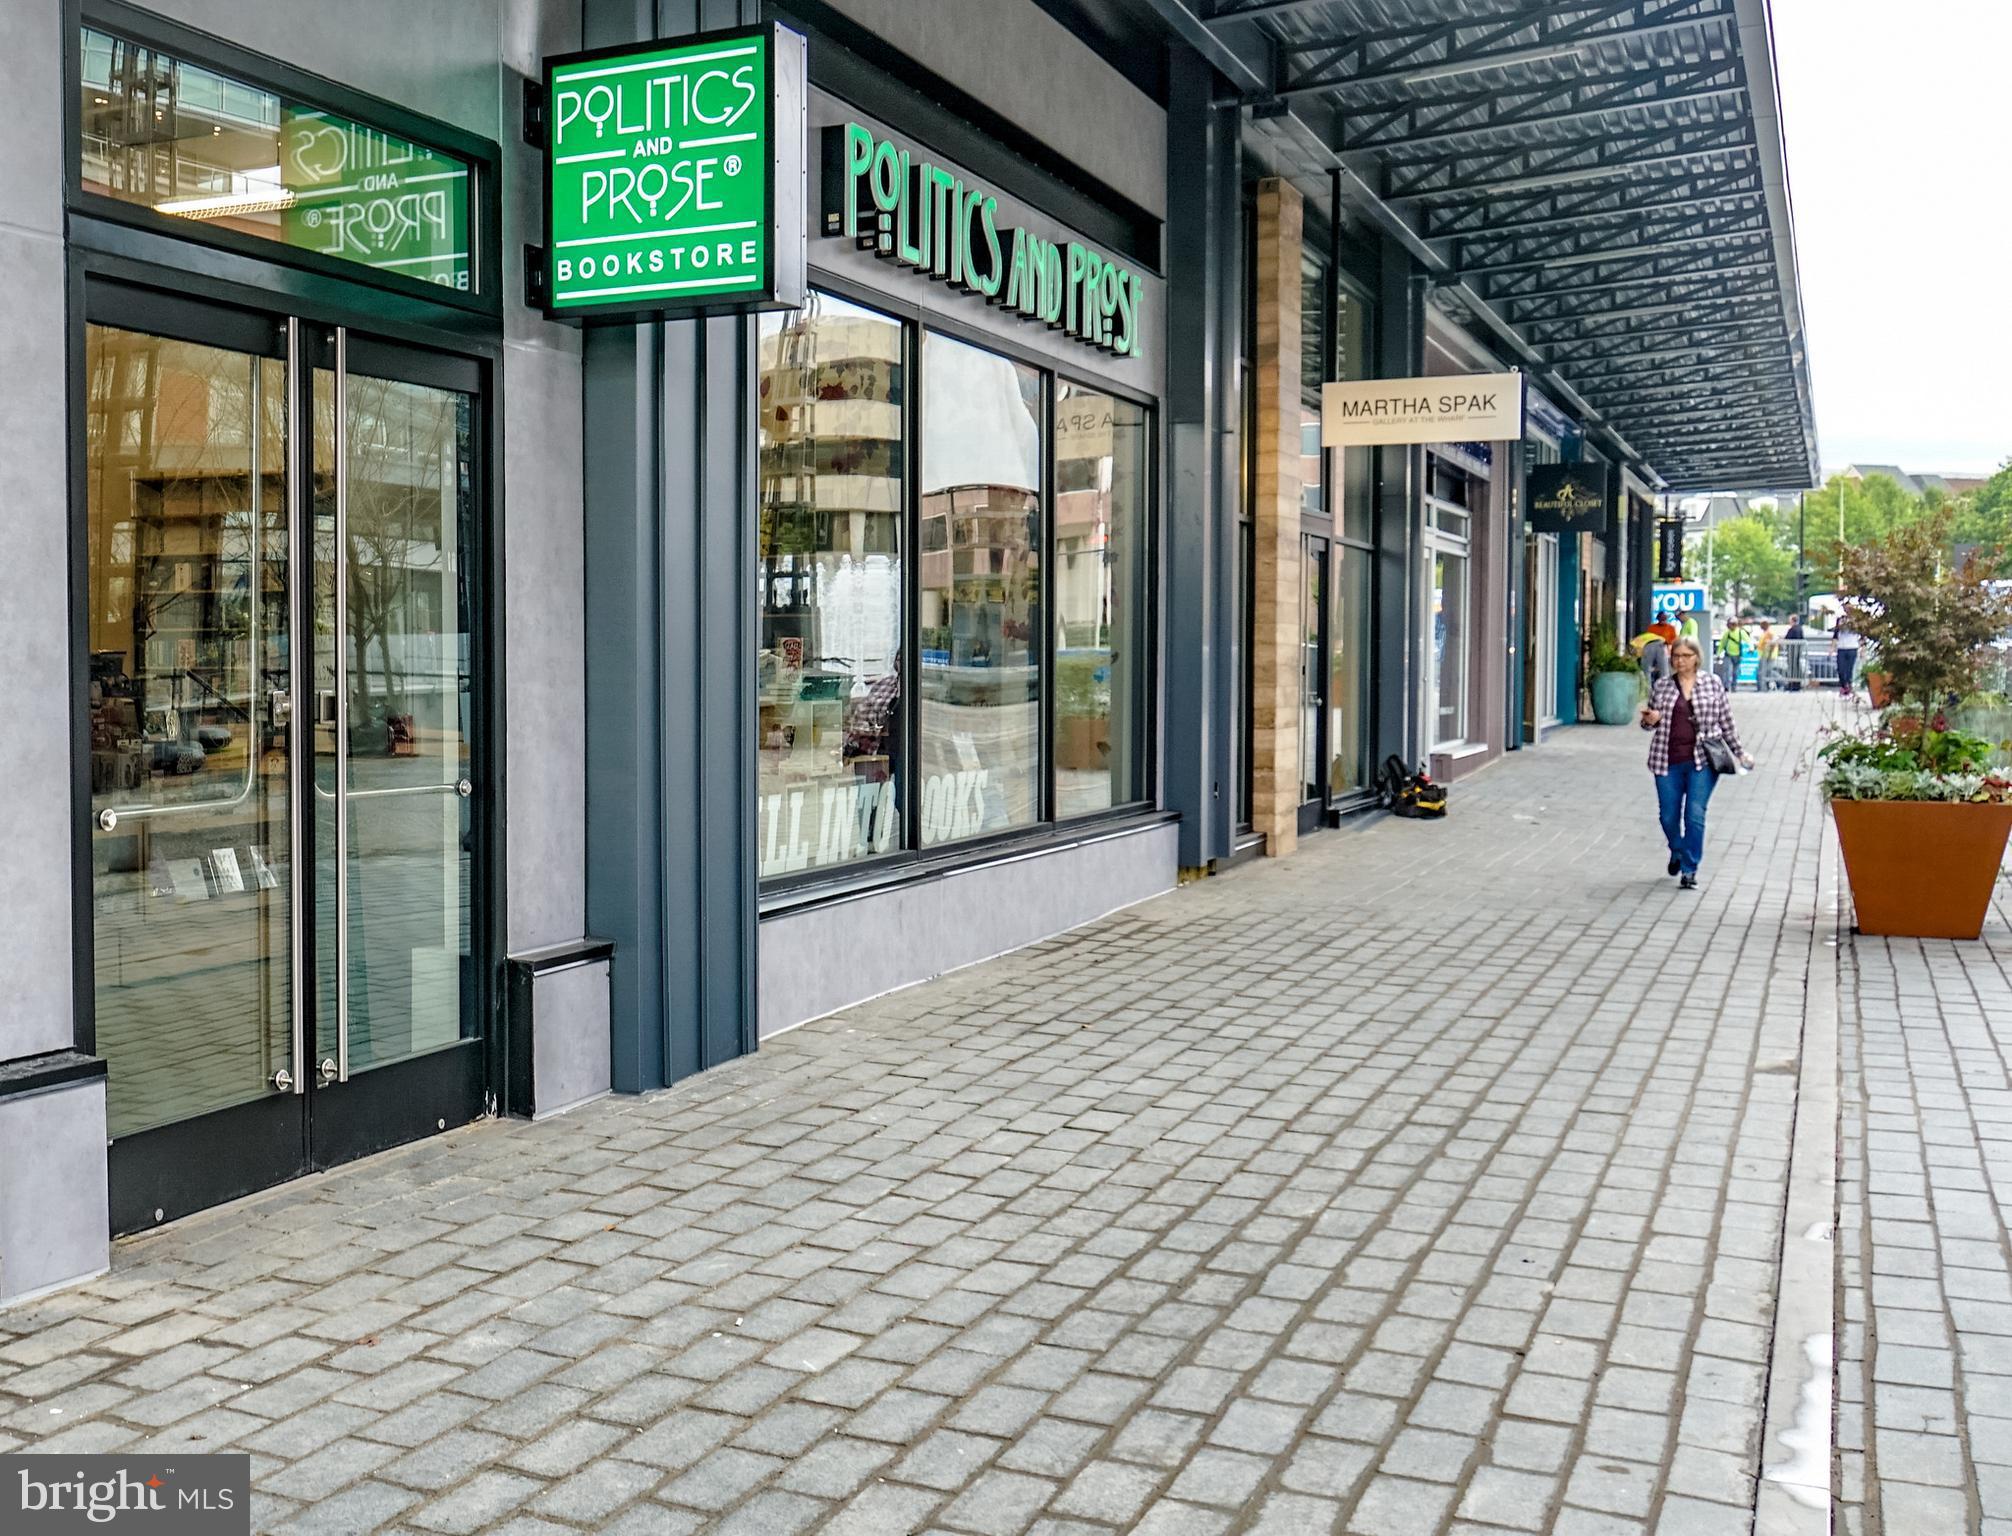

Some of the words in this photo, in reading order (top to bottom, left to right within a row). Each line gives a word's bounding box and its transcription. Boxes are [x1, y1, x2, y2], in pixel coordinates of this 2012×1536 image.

[557, 65, 756, 144] POLITICS
[633, 136, 672, 158] AND
[844, 121, 1002, 296] POLITICS
[1006, 226, 1062, 323] AND
[1067, 241, 1144, 358] PROSE
[557, 240, 757, 282] BOOKSTORE
[1342, 397, 1432, 418] MARTHA
[1438, 393, 1497, 413] SPAK
[1652, 592, 1695, 612] YOU
[921, 769, 988, 845] OOKS
